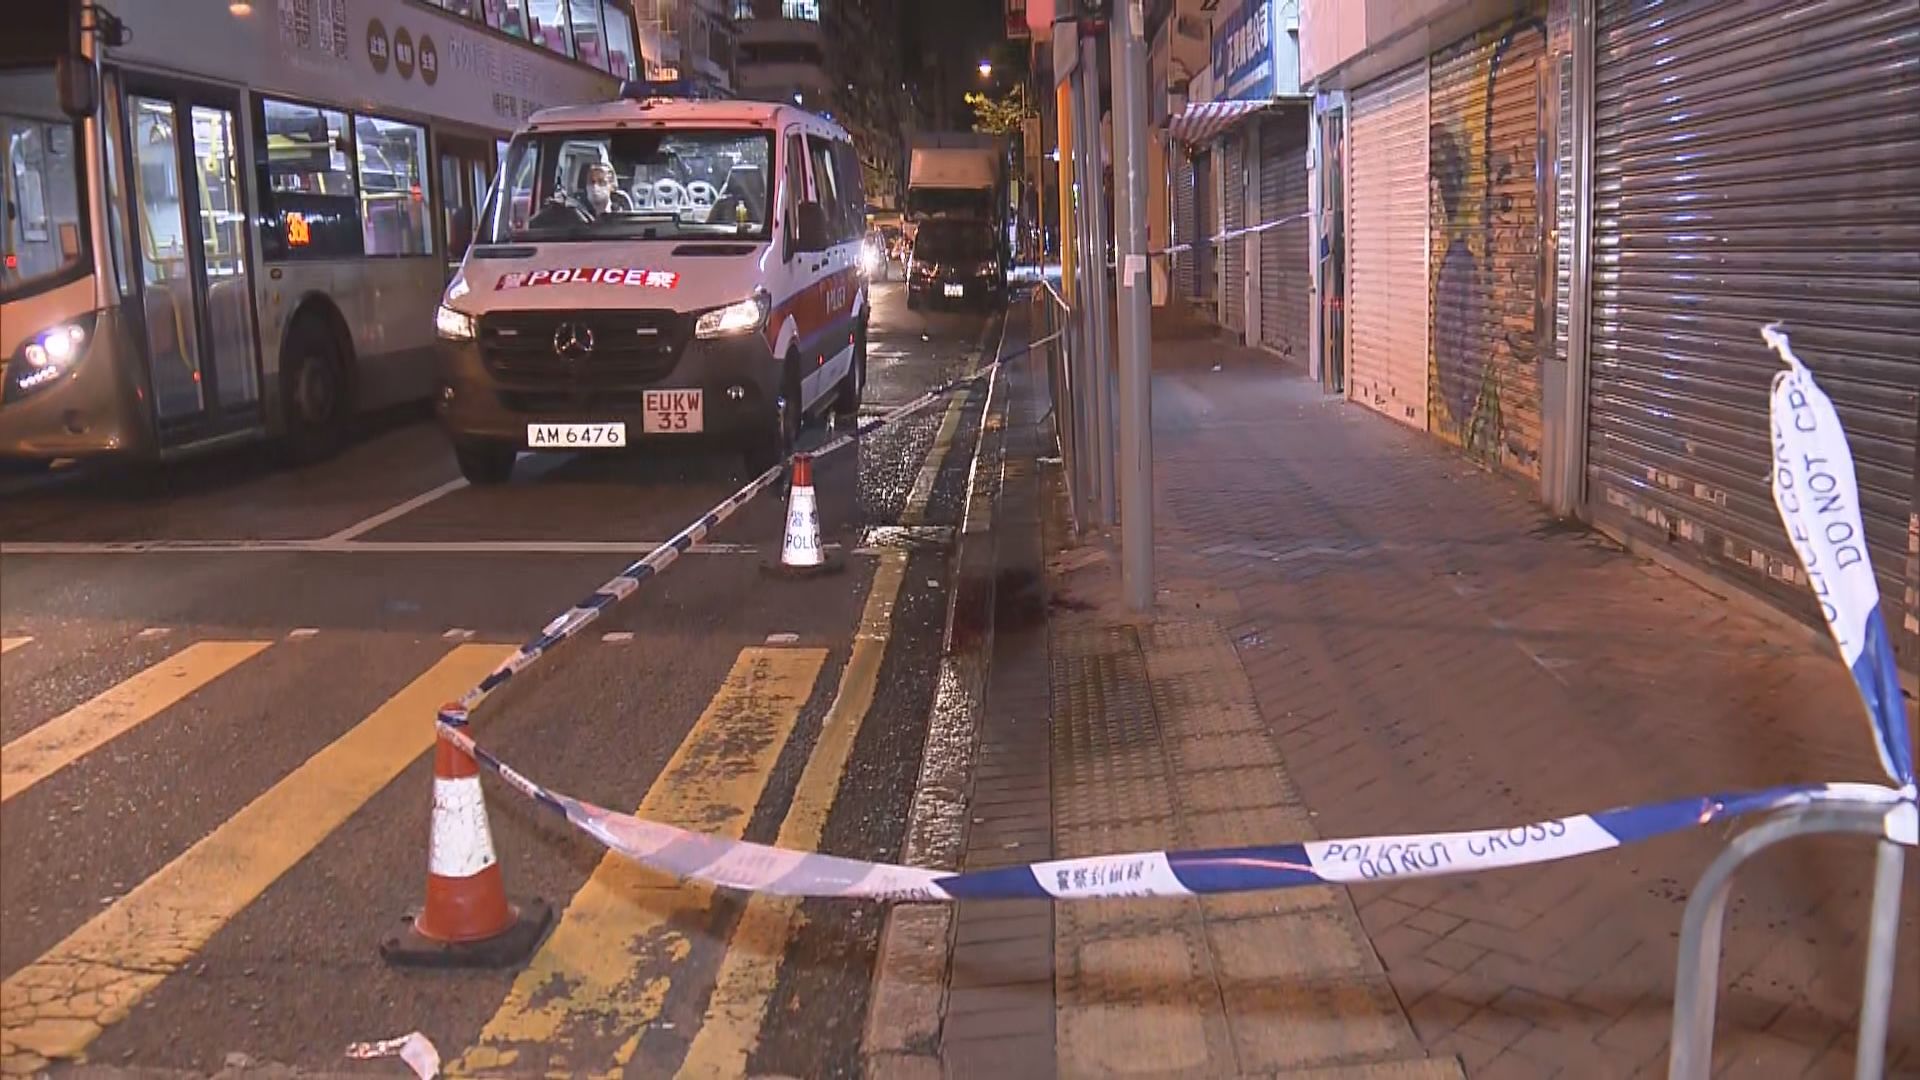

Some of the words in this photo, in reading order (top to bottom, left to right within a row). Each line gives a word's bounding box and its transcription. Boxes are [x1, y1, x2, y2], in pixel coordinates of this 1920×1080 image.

[528, 268, 646, 287] POLICE
[646, 392, 700, 411] EUKW
[657, 411, 688, 430] 33
[534, 426, 560, 444] AM
[565, 426, 620, 444] 6476
[1803, 452, 1845, 514] NOT
[1824, 520, 1863, 572] DO
